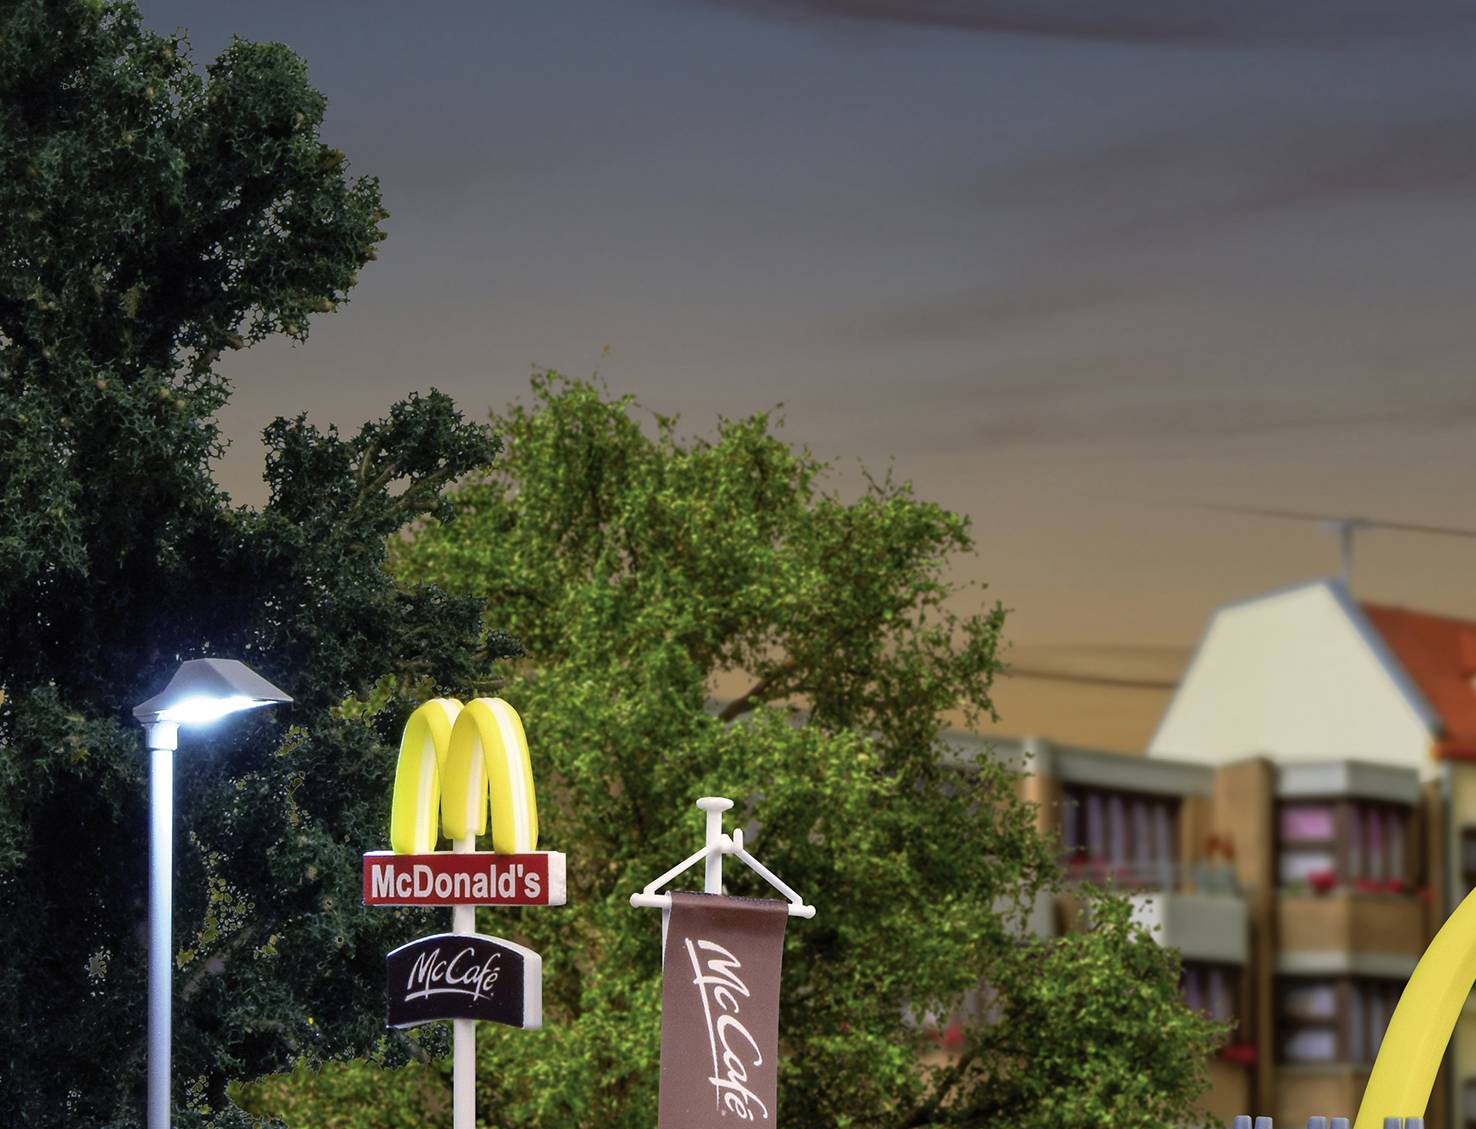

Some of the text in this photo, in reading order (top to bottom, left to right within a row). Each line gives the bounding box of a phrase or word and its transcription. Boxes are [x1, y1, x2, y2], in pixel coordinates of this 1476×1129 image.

[371, 864, 541, 899] McDonald's
[404, 946, 501, 1001] McCafé
[686, 937, 768, 1121] McCafé
